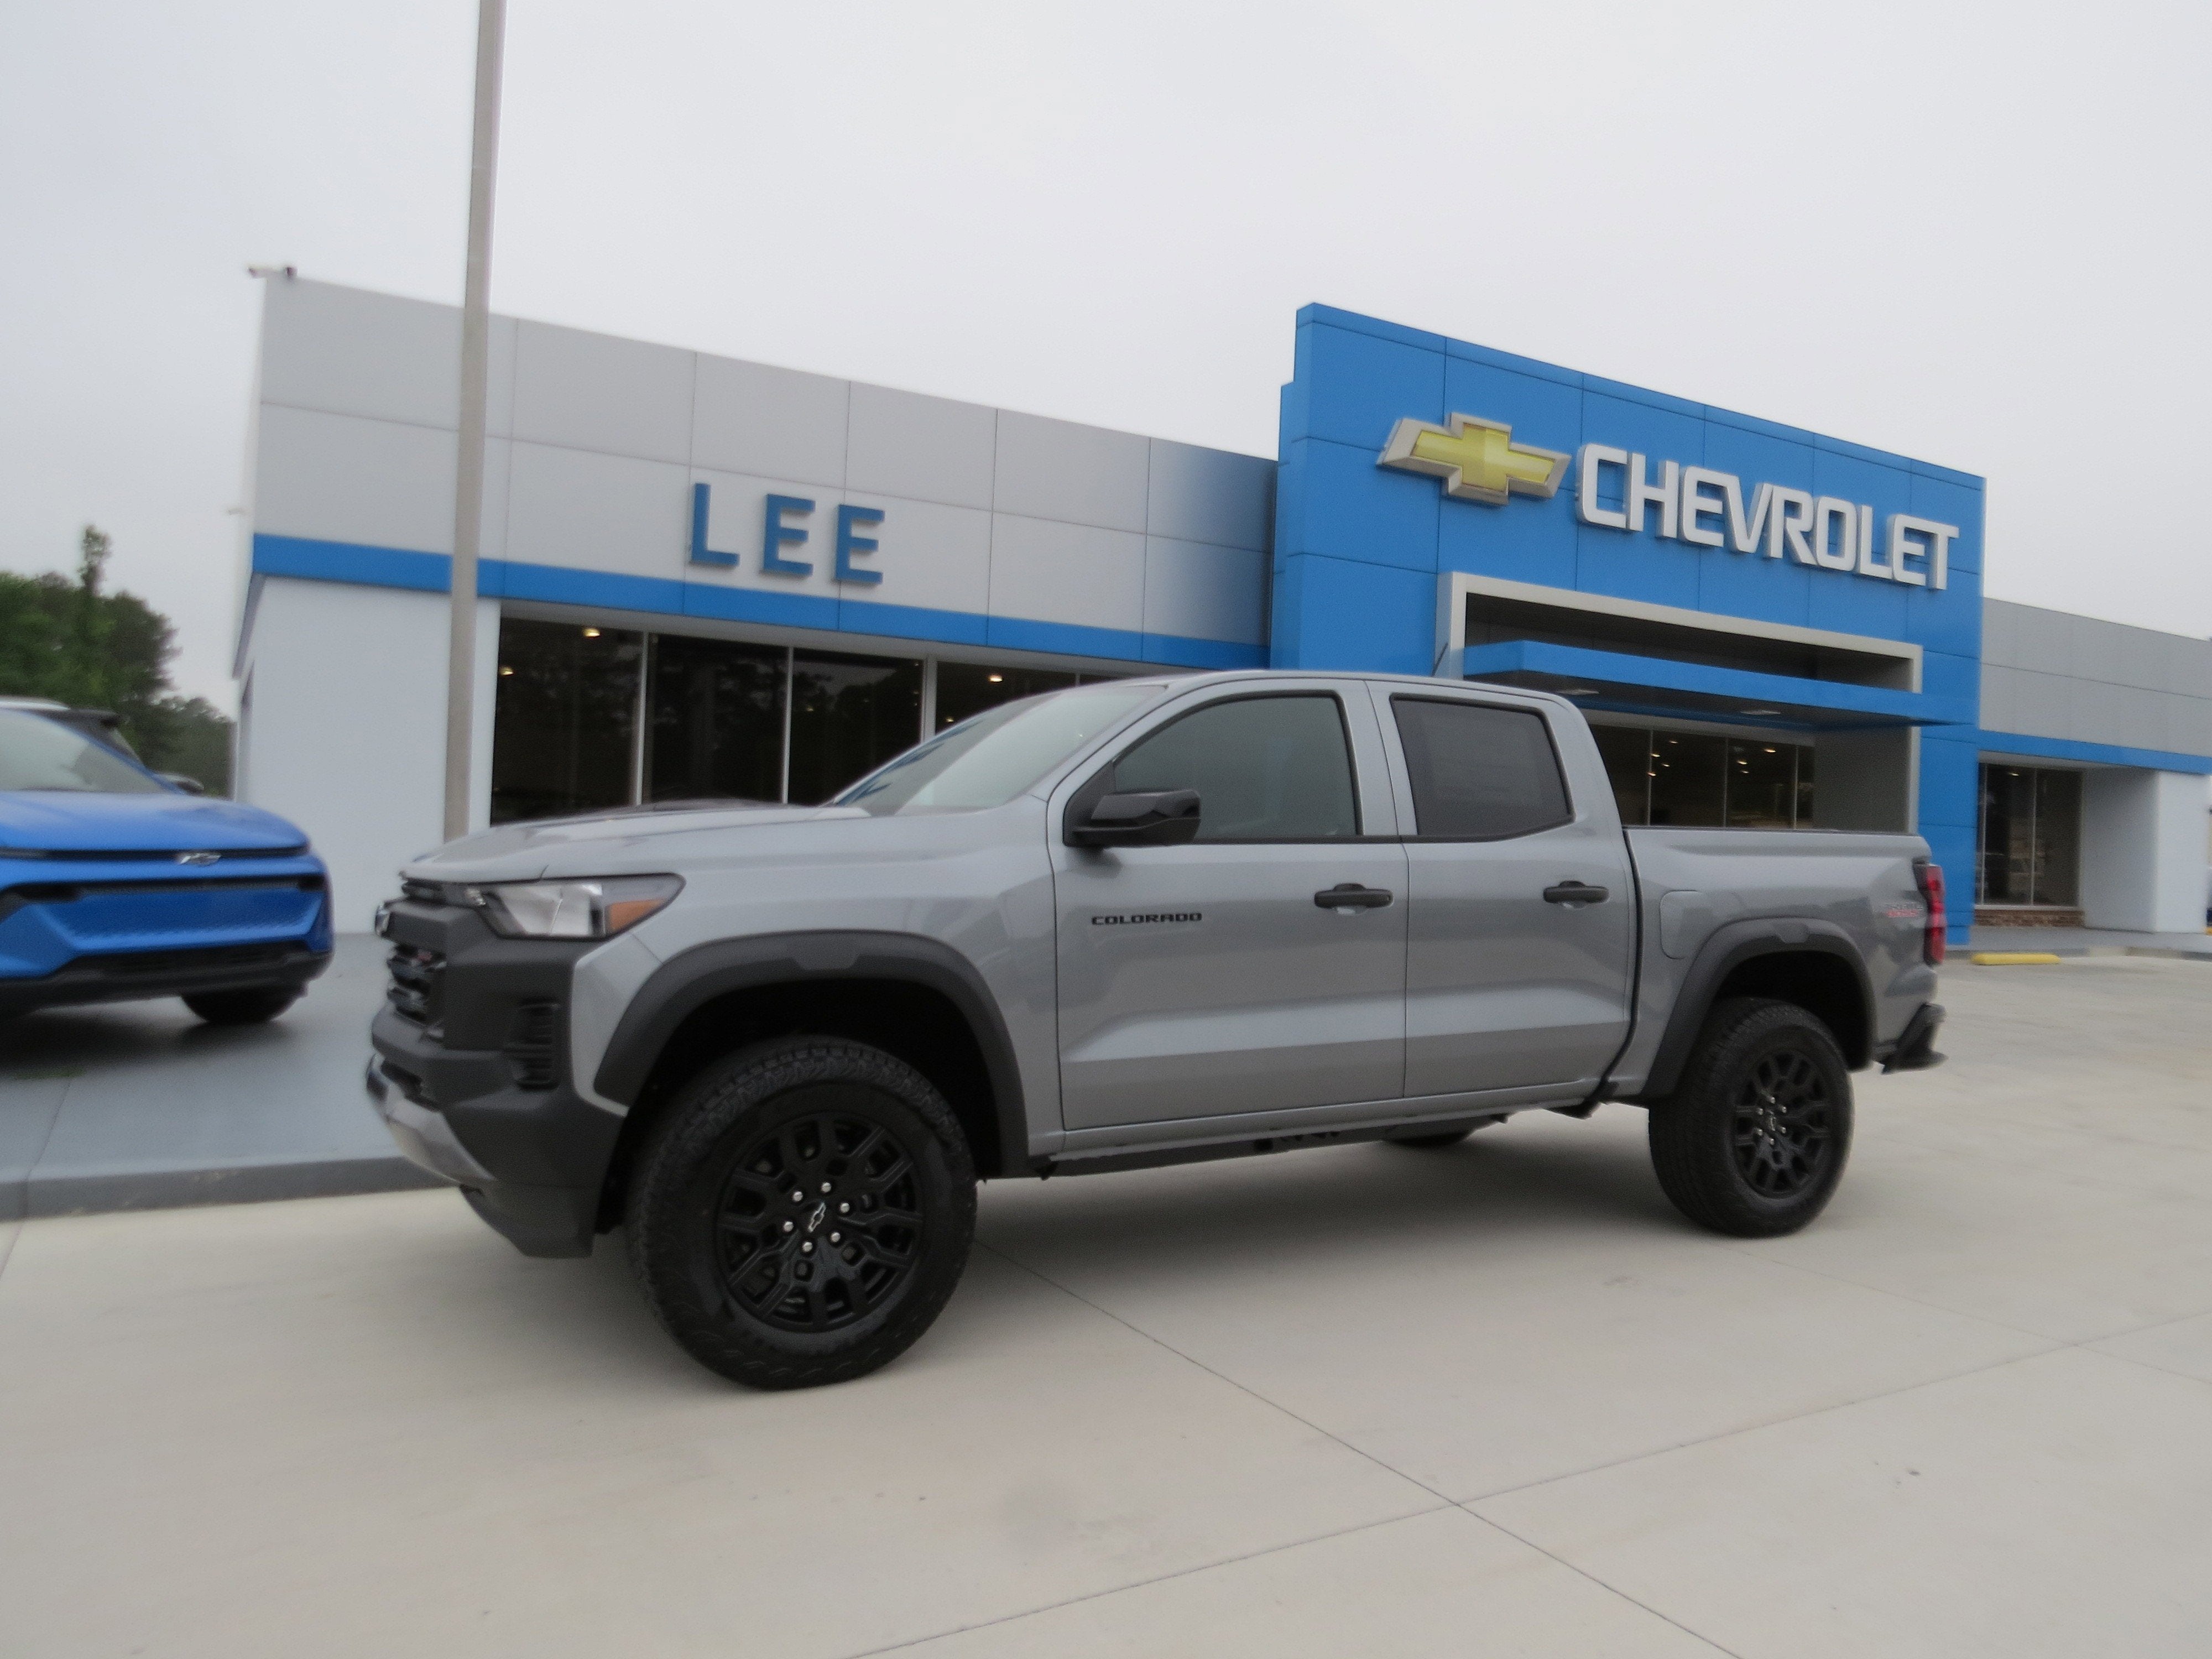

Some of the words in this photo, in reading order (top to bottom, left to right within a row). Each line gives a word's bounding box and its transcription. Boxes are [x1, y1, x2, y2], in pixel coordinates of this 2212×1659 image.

[691, 482, 885, 584] LEE
[1577, 443, 1959, 590] CHEVROLET
[1091, 912, 1202, 925] COLORADO
